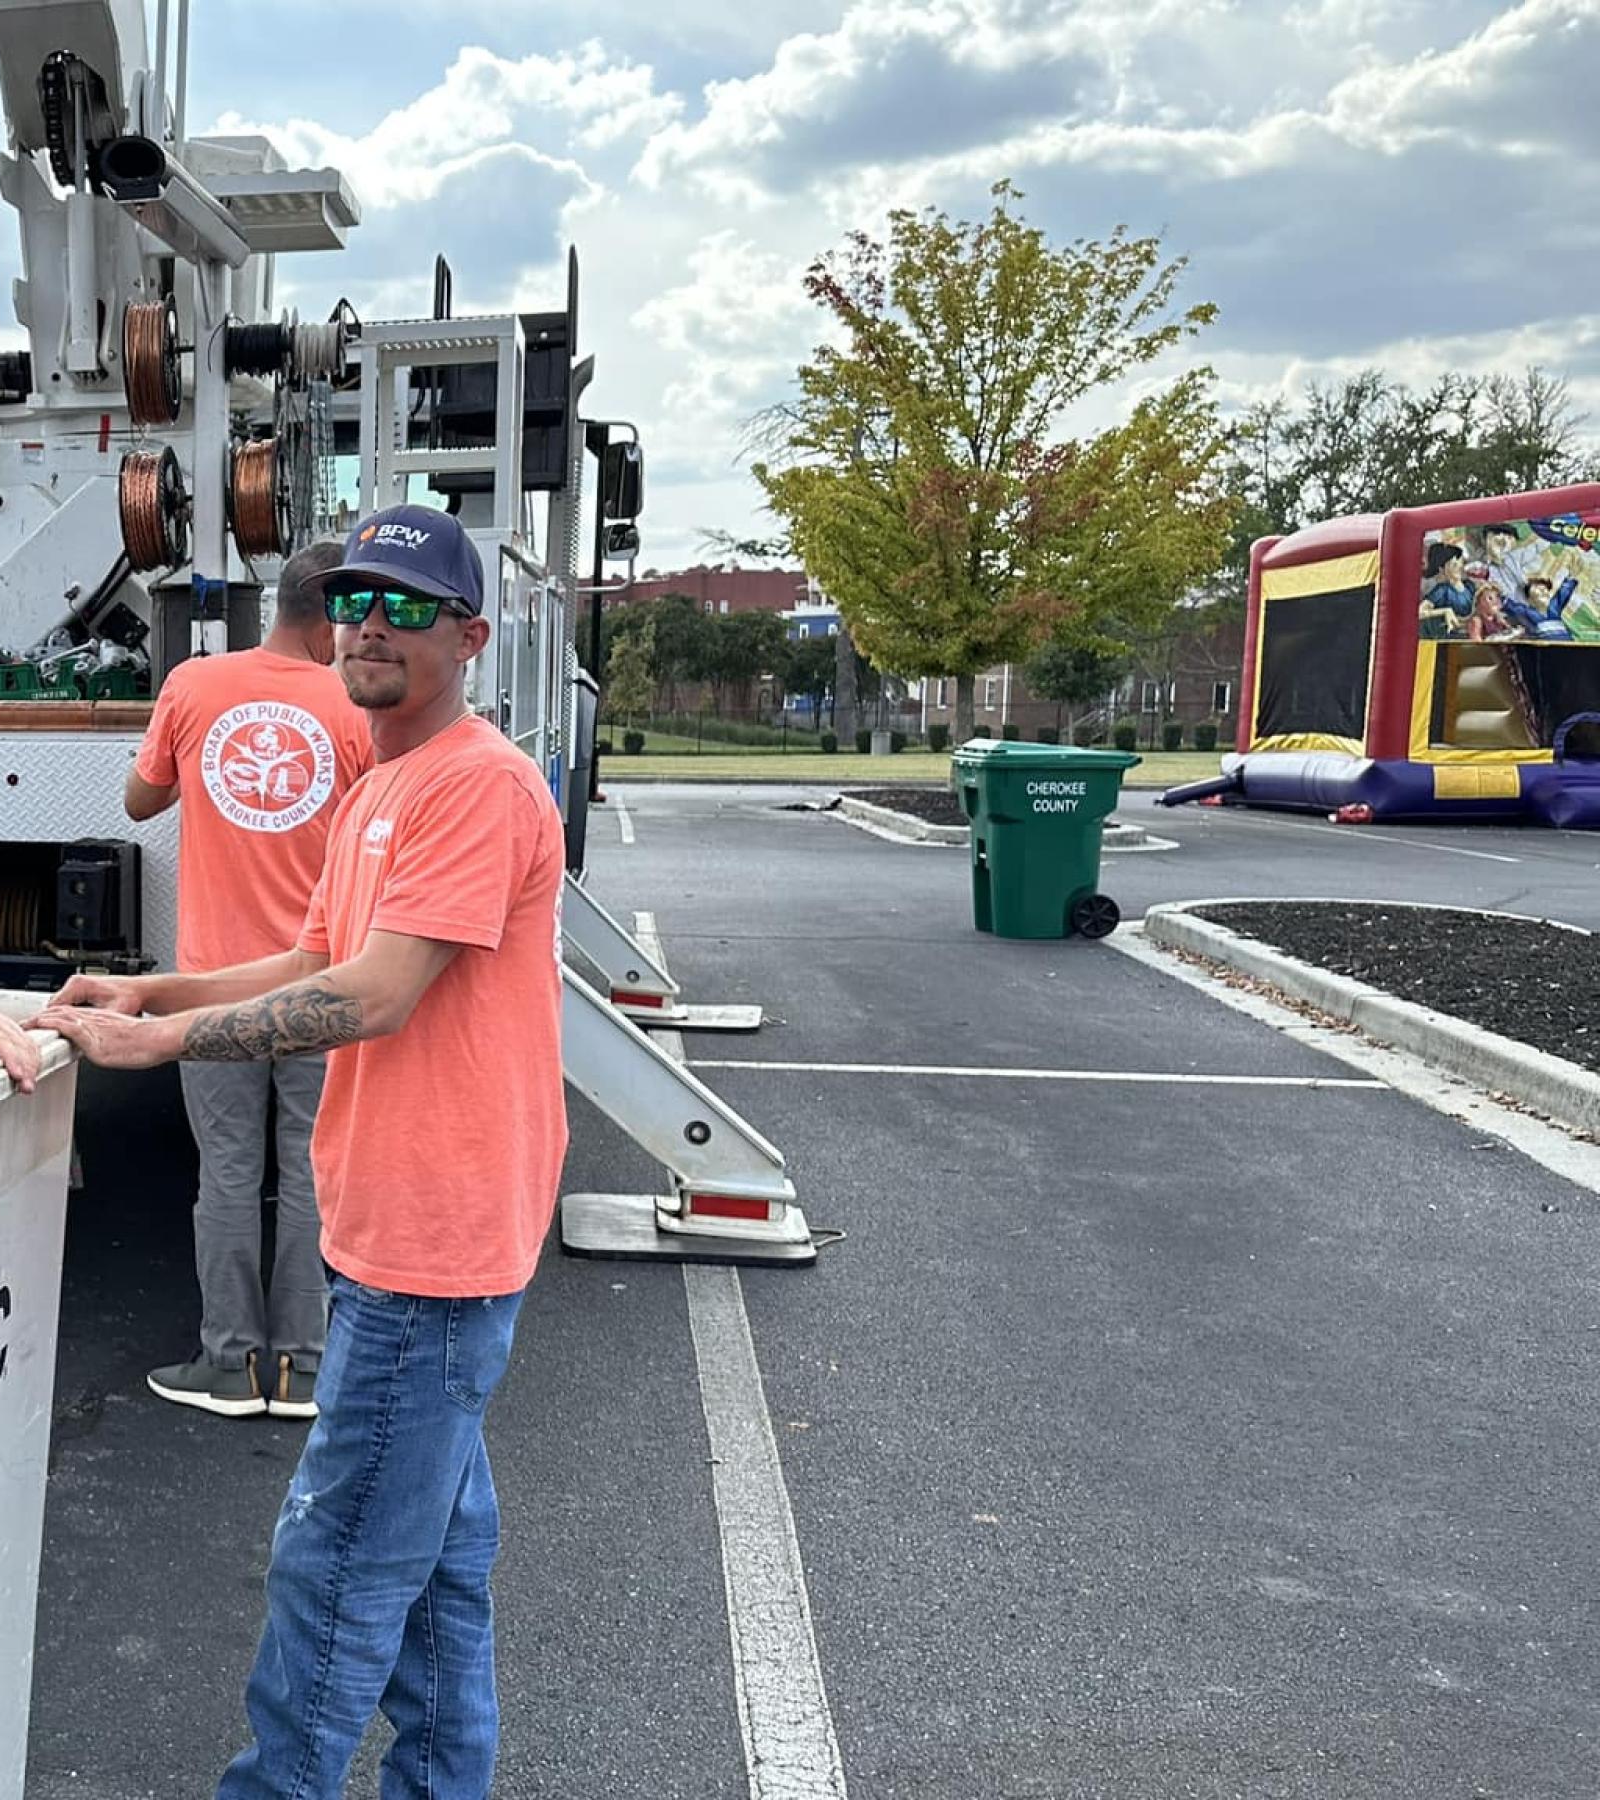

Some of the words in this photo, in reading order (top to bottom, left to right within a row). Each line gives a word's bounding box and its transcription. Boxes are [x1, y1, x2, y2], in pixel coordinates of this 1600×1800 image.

[377, 524, 431, 544] BPW
[1550, 518, 1600, 542] Cele
[204, 718, 232, 771] BOARD
[232, 709, 253, 721] OF
[257, 704, 314, 732] PUBLIC
[309, 729, 333, 787] WORKS
[1026, 781, 1087, 796] CHEROKEE
[210, 781, 269, 828] CHEROKEE
[272, 793, 322, 829] COUNTY
[1032, 799, 1079, 813] COUNTY
